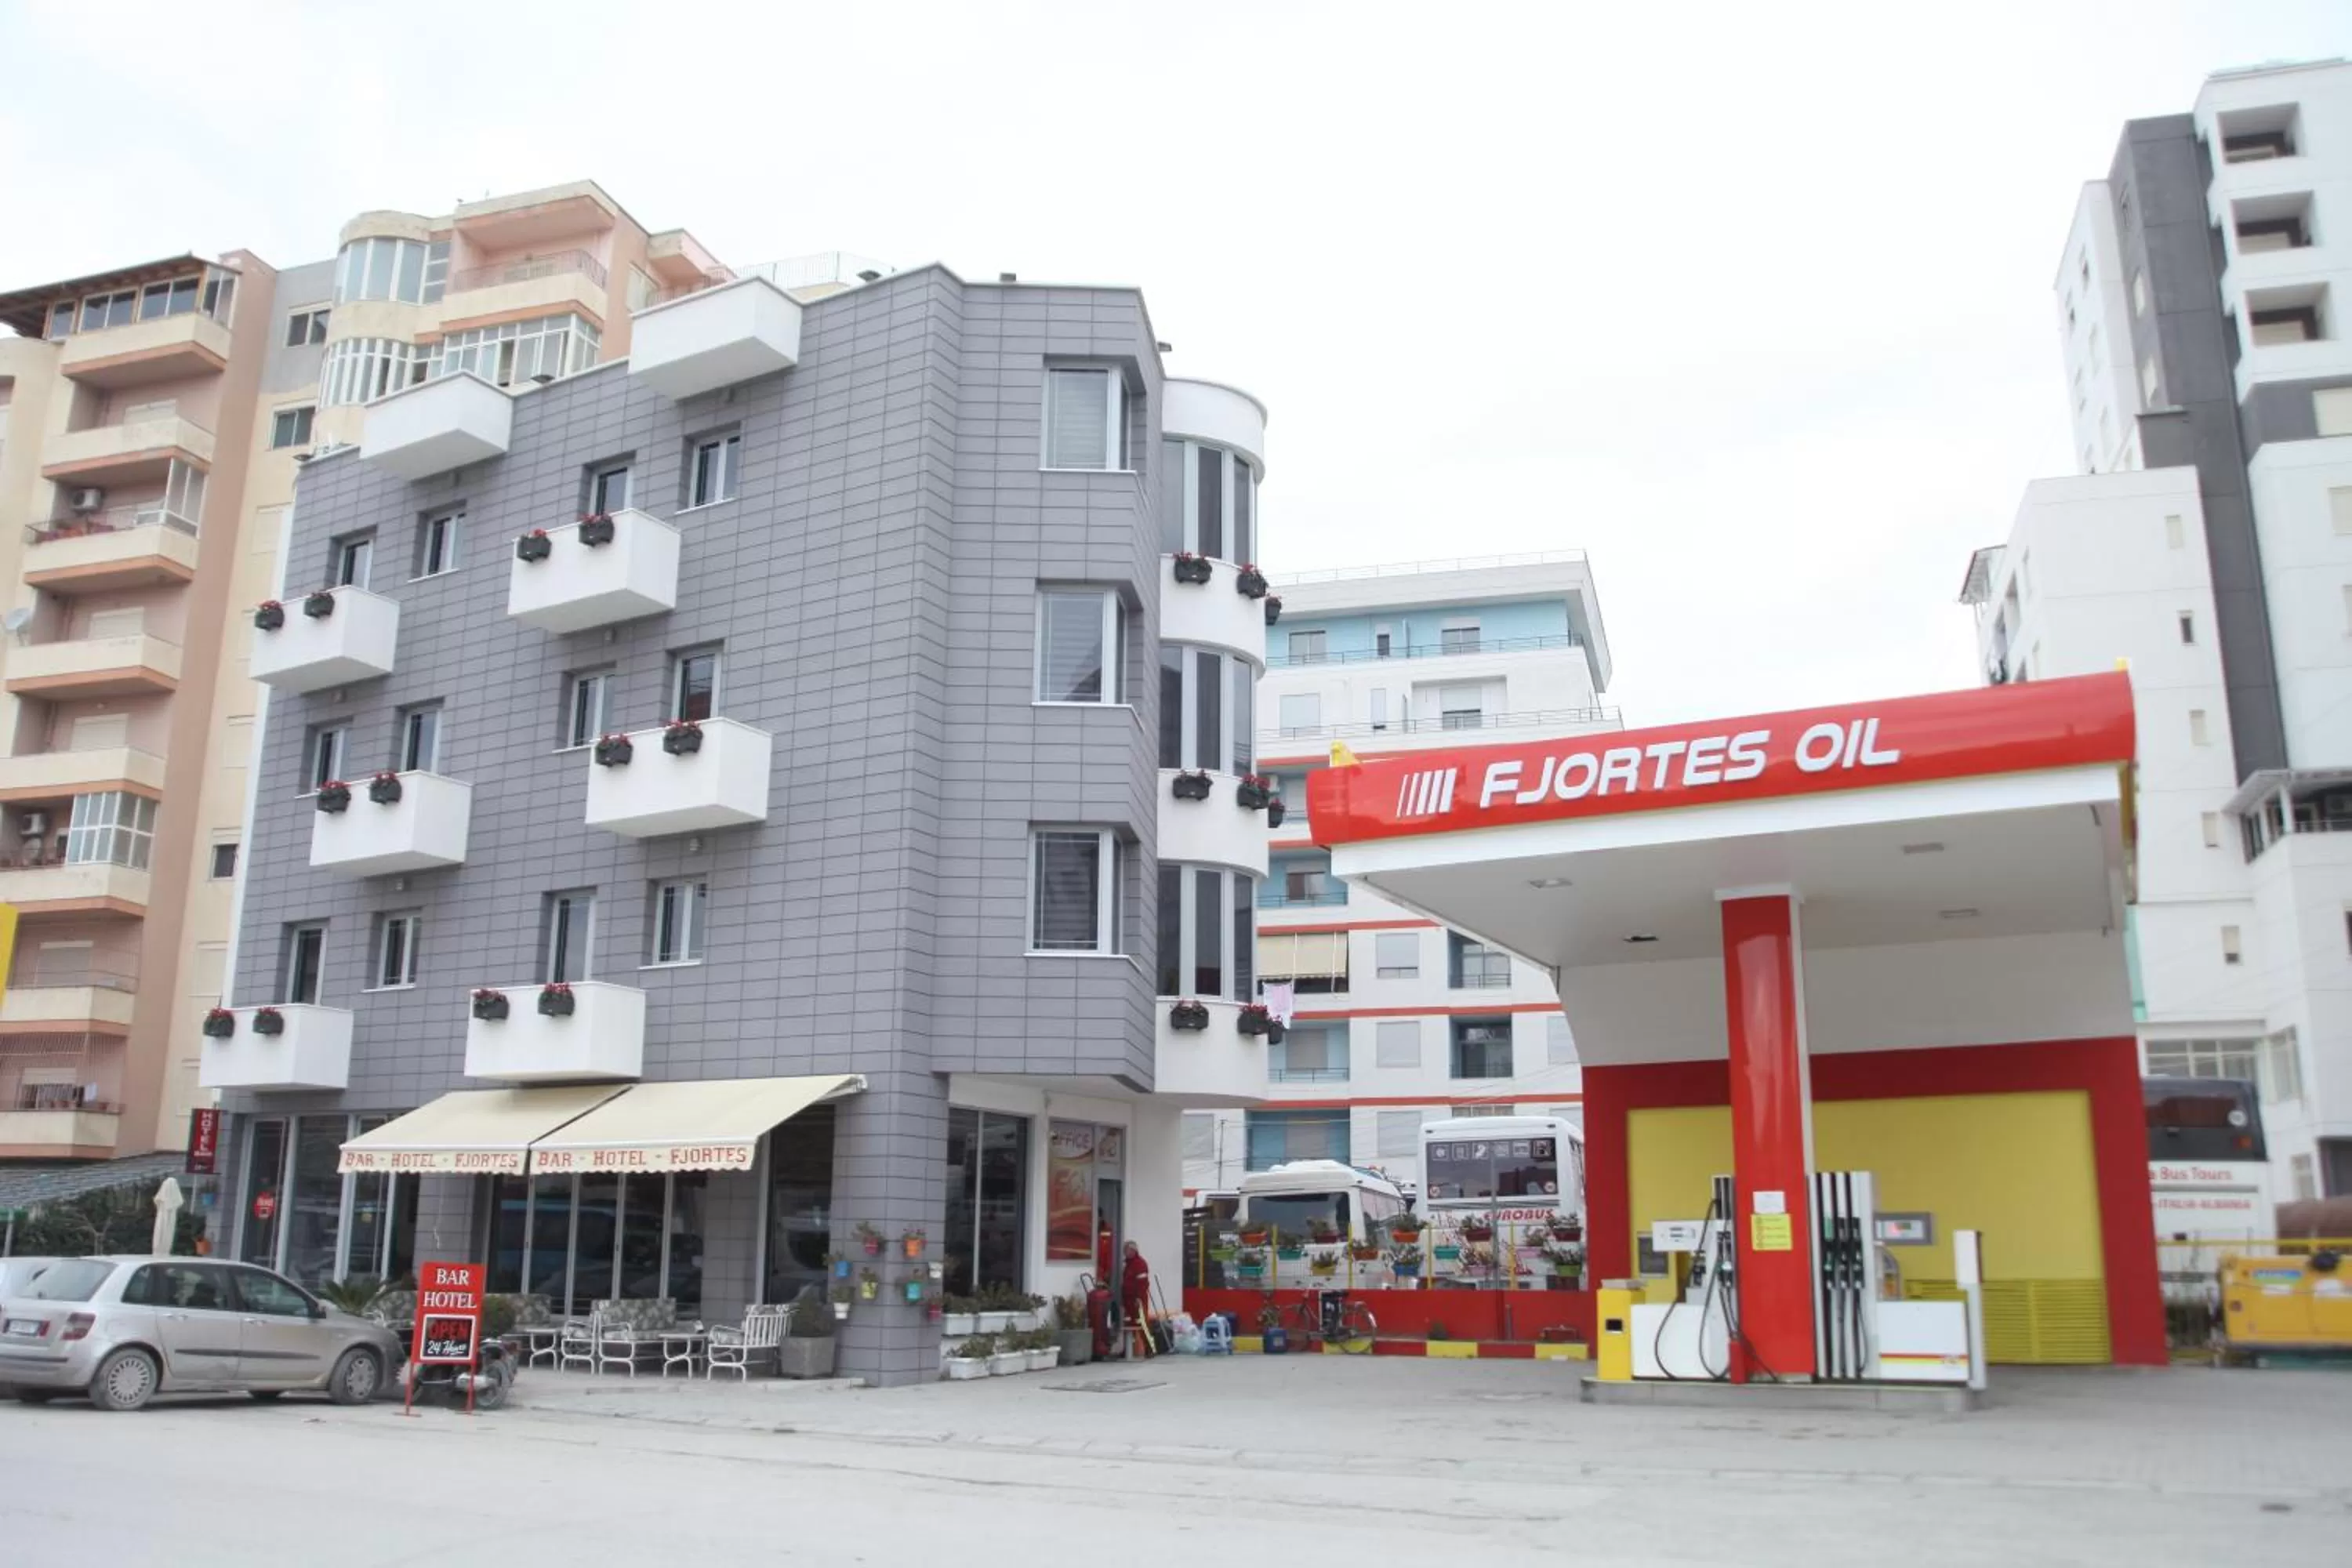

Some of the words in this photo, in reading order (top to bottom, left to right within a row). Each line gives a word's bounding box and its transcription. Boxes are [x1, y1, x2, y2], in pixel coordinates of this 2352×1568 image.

[1479, 729, 1770, 808] FJORTES
[1794, 717, 1900, 773] OIL
[200, 1111, 213, 1151] HOTEL
[345, 1153, 375, 1167] BAR
[391, 1154, 436, 1167] HOTEL
[455, 1154, 518, 1167] FJORTES
[539, 1151, 572, 1167] BAR
[593, 1150, 647, 1166] HOTEL
[671, 1148, 747, 1164] FJORTES
[2160, 1167, 2187, 1180] Bus
[436, 1268, 470, 1285] BAR
[423, 1291, 477, 1308] HOTEL
[429, 1319, 468, 1339] OPEN
[427, 1340, 441, 1355] 24
